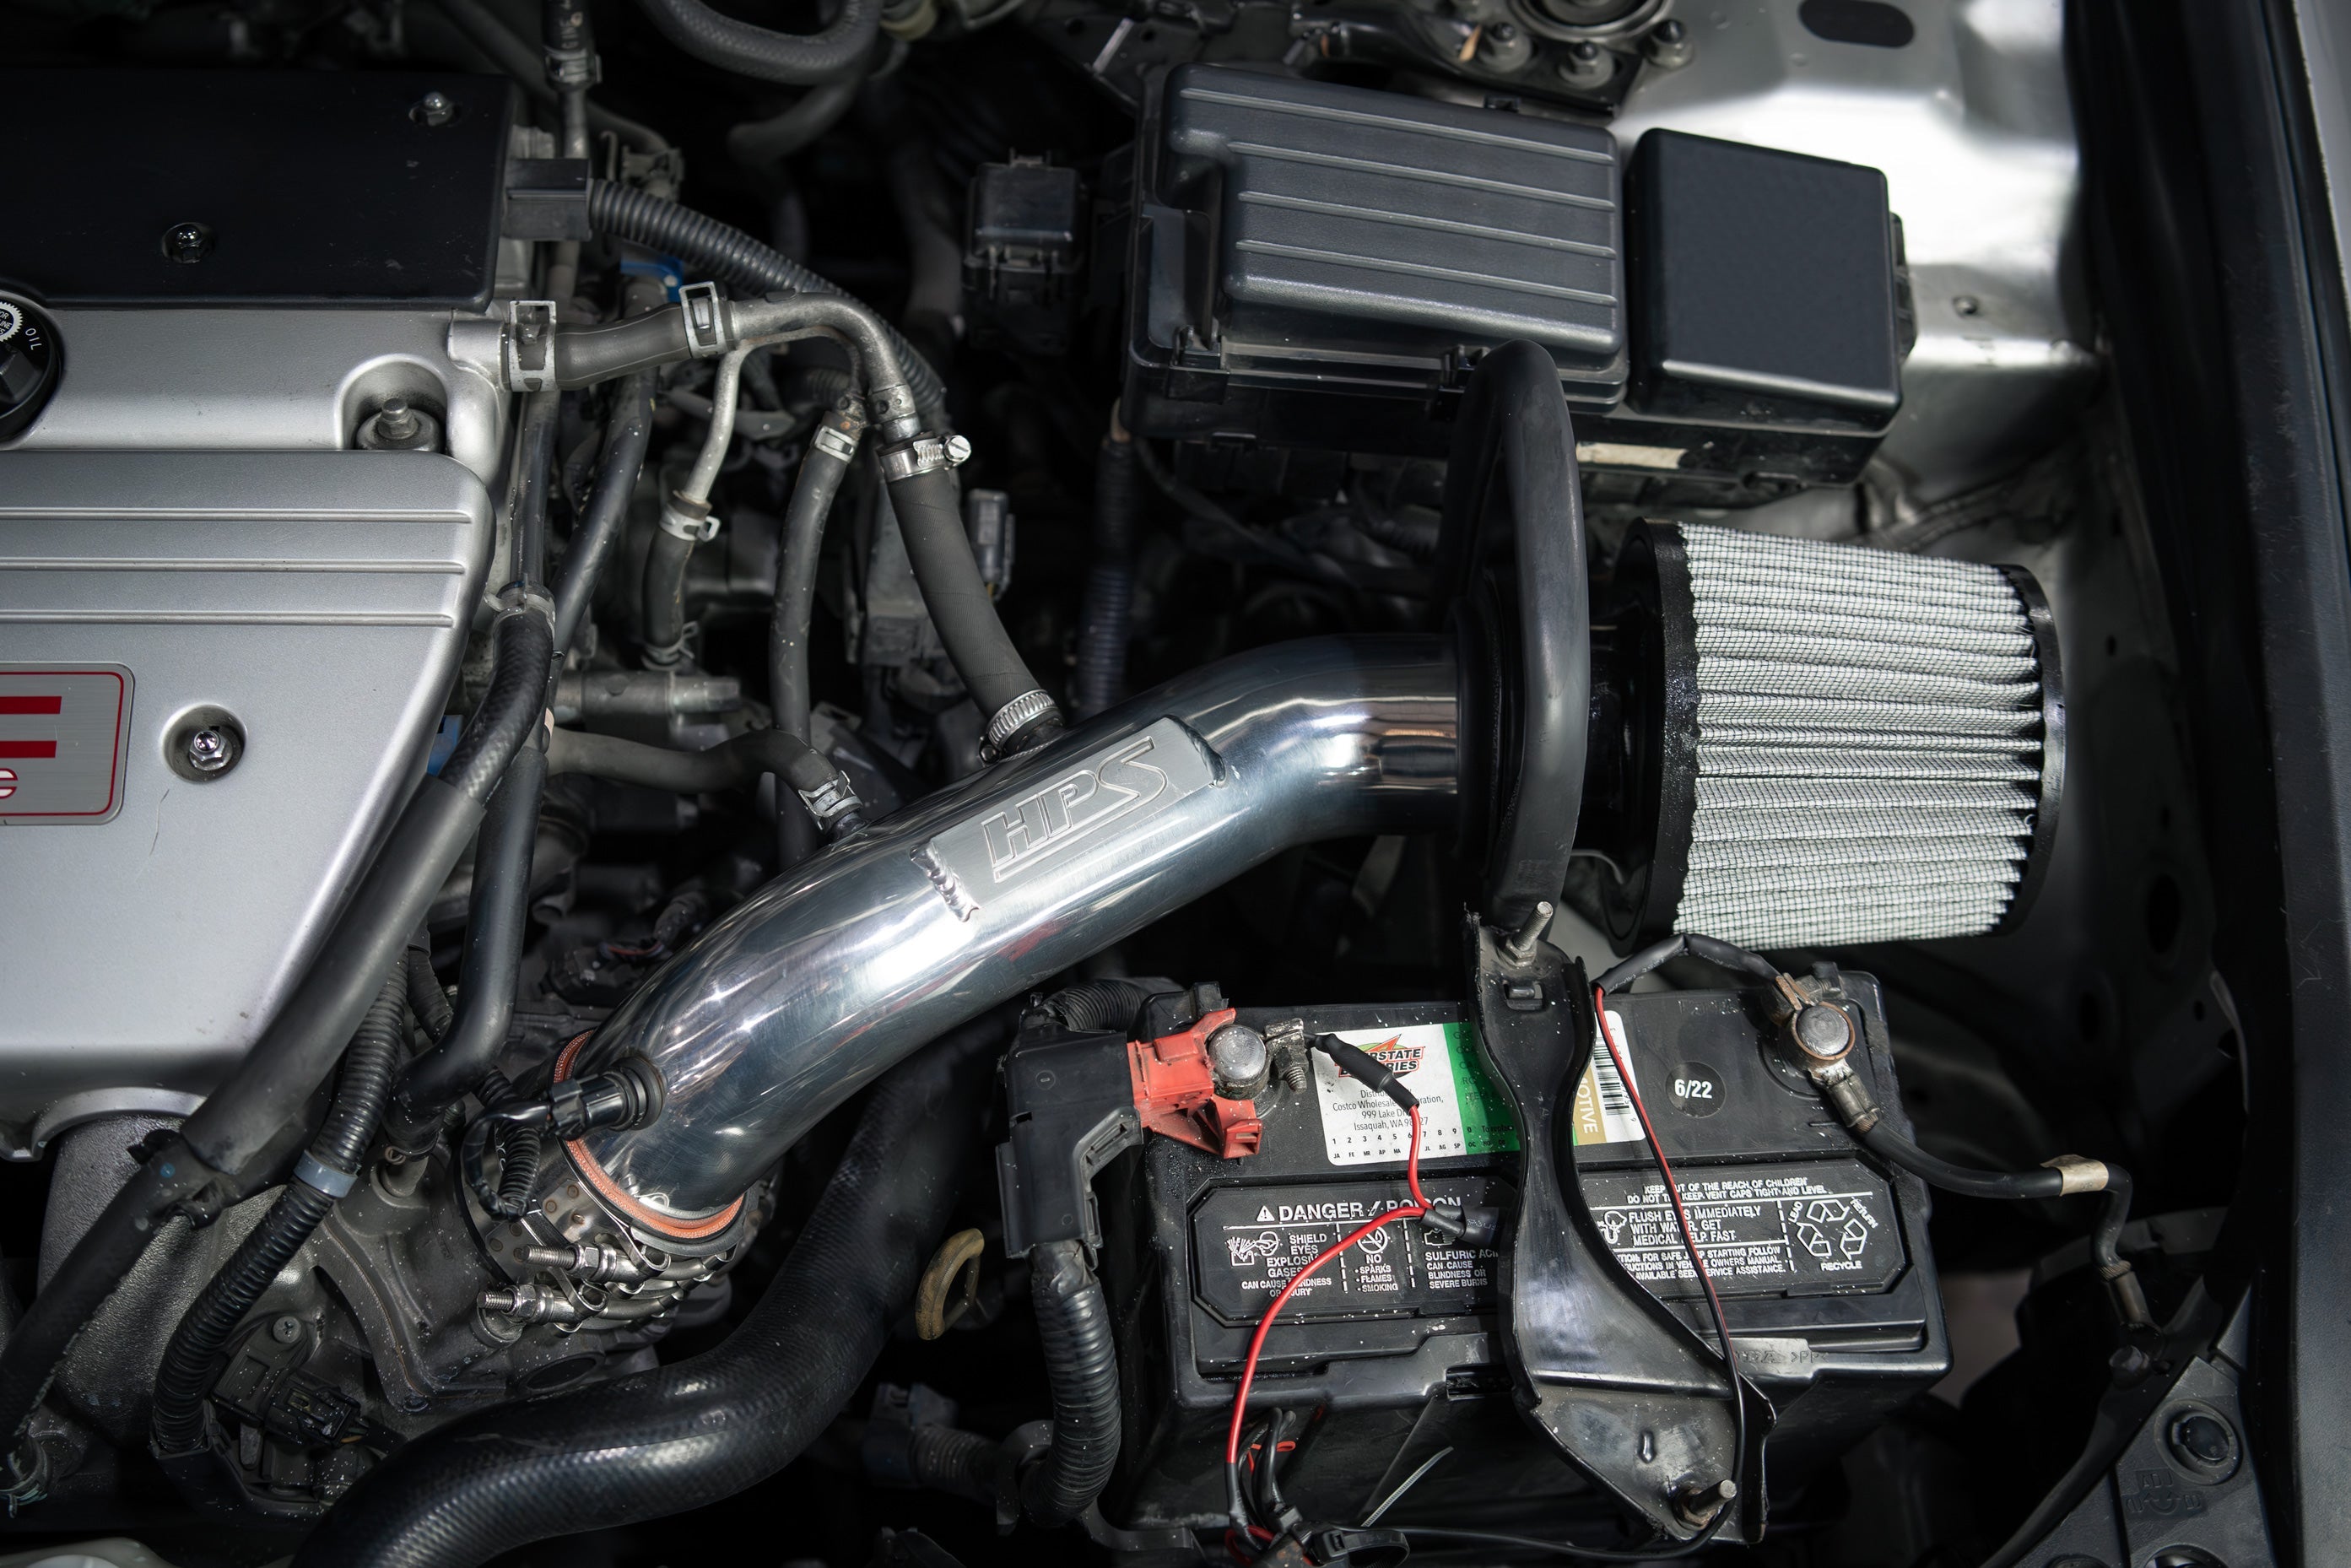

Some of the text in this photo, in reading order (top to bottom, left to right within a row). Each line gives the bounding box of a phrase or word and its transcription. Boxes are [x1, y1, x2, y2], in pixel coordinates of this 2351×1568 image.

[25, 328, 42, 350] OIL
[981, 735, 1169, 884] HPS
[1674, 1079, 1712, 1099] 6/22
[1332, 1095, 1444, 1111] Costco Wholesale ration,
[1361, 1111, 1377, 1119] 999
[1379, 1110, 1395, 1118] Lake
[1354, 1117, 1429, 1131] Issaquah, WA 9827
[1644, 1177, 1808, 1194] KEEP UT OF THE REACH OF CHILDREN
[1627, 1195, 1640, 1204] DO
[1642, 1193, 1660, 1203] NOT
[1705, 1190, 1727, 1199] VENT
[1729, 1189, 1753, 1198] CAPS
[1754, 1187, 1779, 1197] TIGHT
[1782, 1186, 1800, 1196] AND
[1278, 1202, 1365, 1221] DANGER
[1629, 1205, 1761, 1223] FLUSH EYS IMMEDIATELY
[1788, 1201, 1803, 1224] LEAD
[1850, 1198, 1879, 1229] RETURN
[1629, 1223, 1657, 1235] WITH
[1700, 1219, 1721, 1230] GET
[1289, 1233, 1327, 1244] SHIELD
[1633, 1233, 1678, 1246] MEDICAL
[1290, 1245, 1318, 1256] EYES
[1425, 1250, 1477, 1261] SULFURIC
[1642, 1253, 1660, 1262] FOR
[1661, 1252, 1682, 1261] SAFE
[1707, 1247, 1747, 1258] STARTING
[1748, 1246, 1781, 1257] FOLLOW
[1267, 1254, 1319, 1267] EXPLOSIV
[1366, 1254, 1382, 1264] NO
[1426, 1261, 1473, 1270] CAN CAUSE
[1666, 1261, 1674, 1270] IN
[1711, 1257, 1745, 1267] OWNERS
[1359, 1265, 1392, 1274] SPARKS
[1705, 1267, 1733, 1277] ERVICE
[1820, 1260, 1863, 1272] RECYCLE
[1361, 1274, 1392, 1284] FLAMES
[1428, 1268, 1487, 1279] BLINDNESS OR
[1241, 1281, 1259, 1290] CAN
[1260, 1279, 1287, 1290] CAUSE
[1362, 1284, 1399, 1293] SMOKING
[1430, 1278, 1488, 1289] SEVERE BURNS
